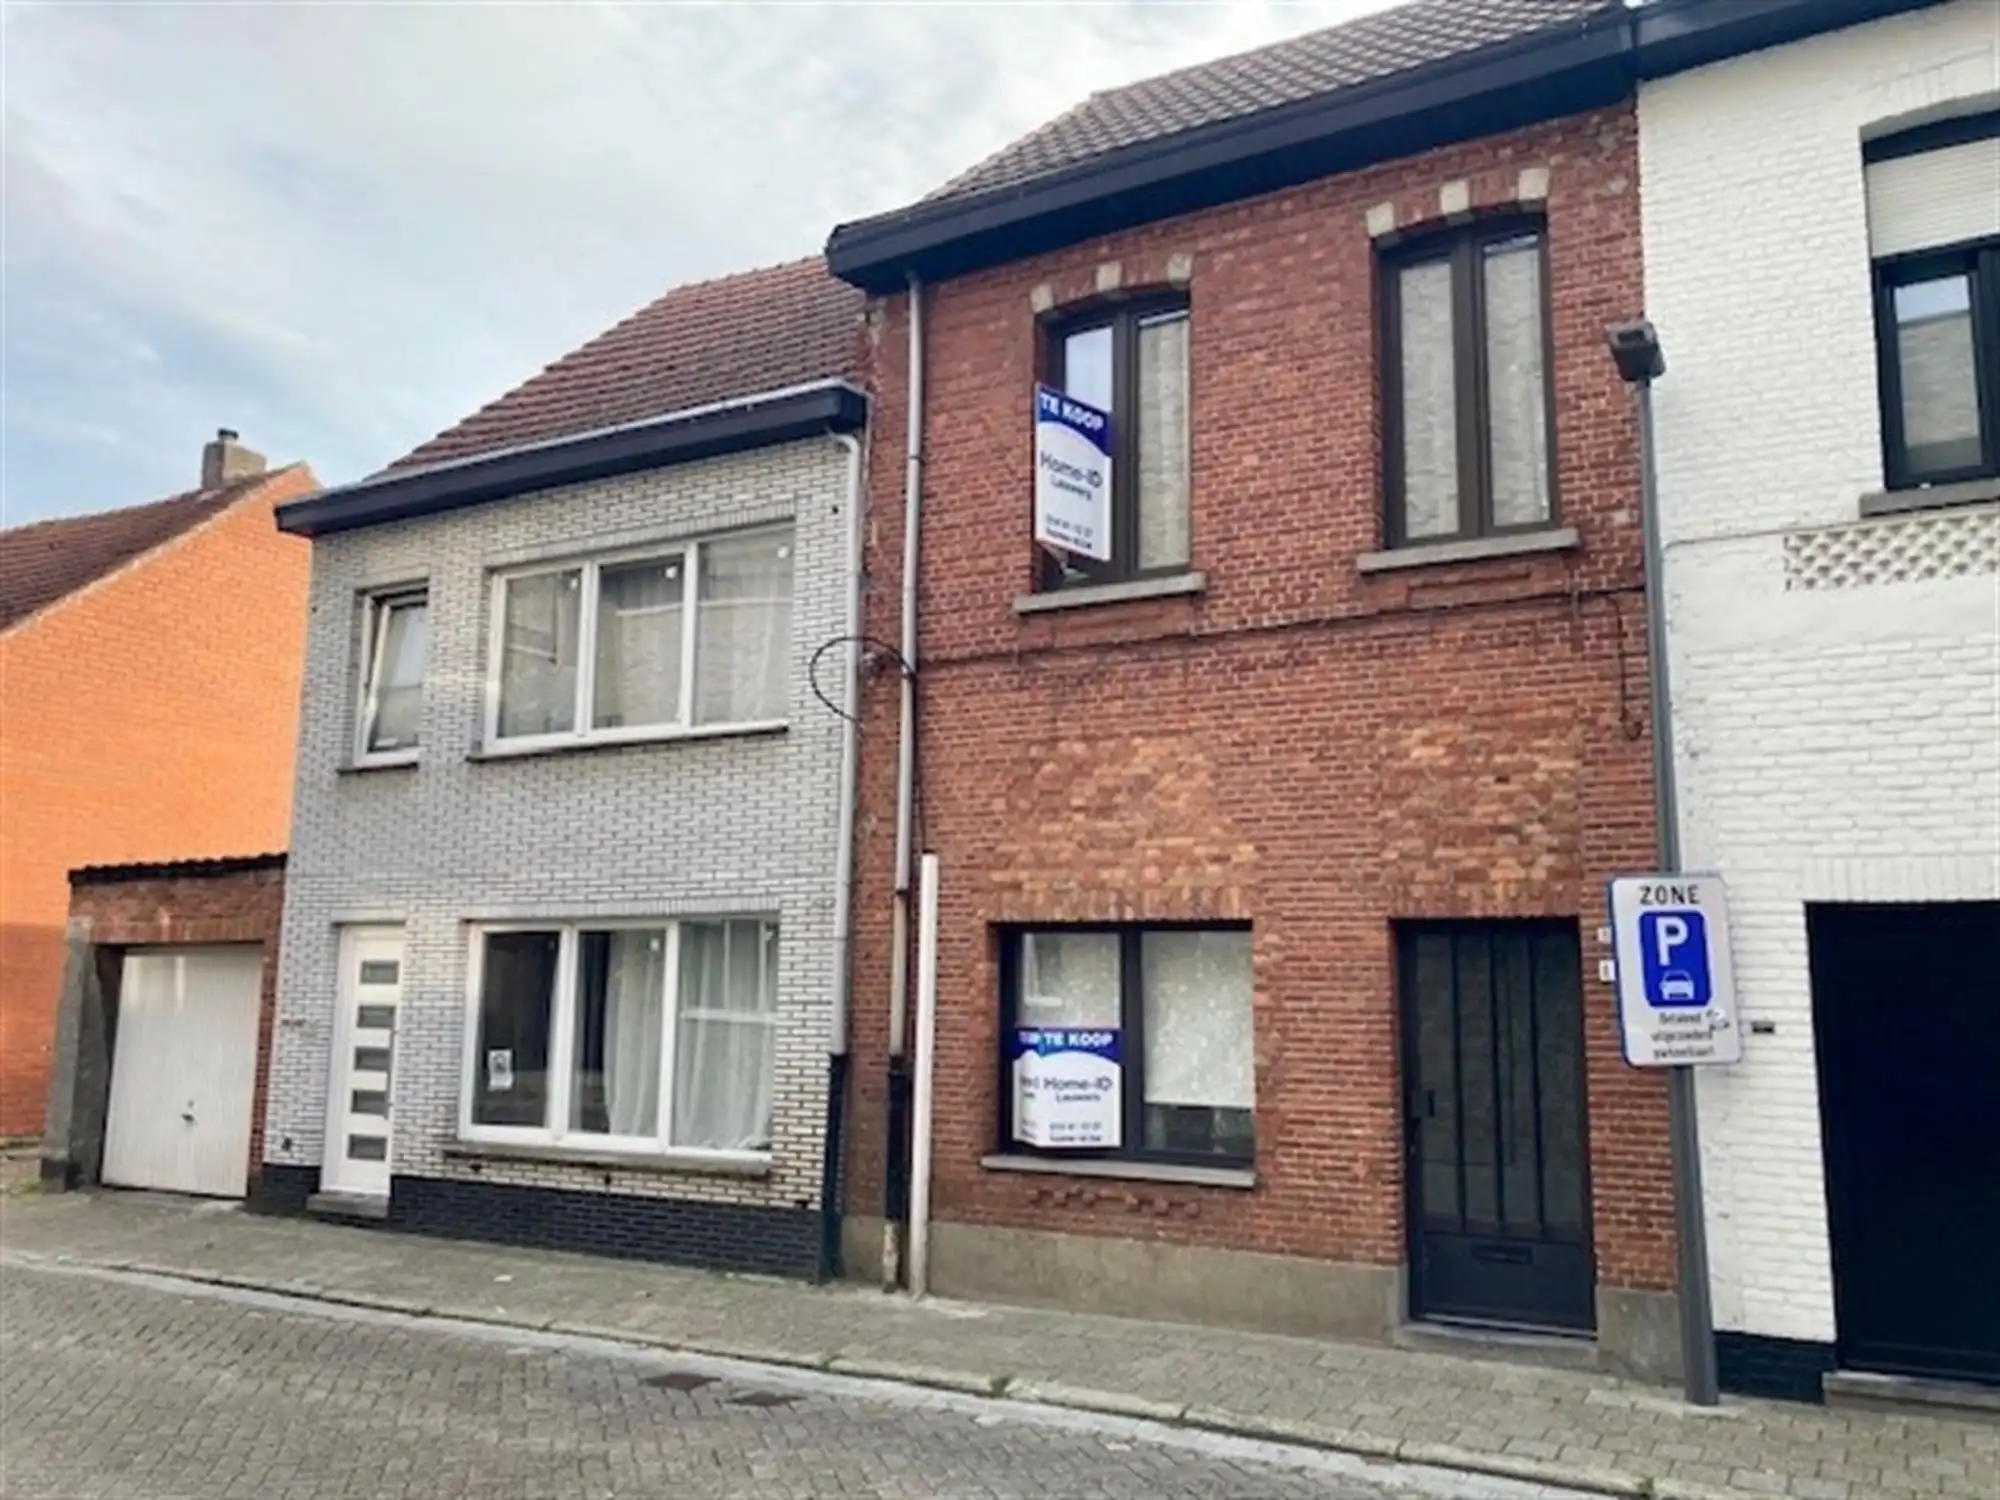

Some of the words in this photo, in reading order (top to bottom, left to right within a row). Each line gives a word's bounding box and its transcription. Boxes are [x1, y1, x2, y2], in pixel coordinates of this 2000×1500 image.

[1040, 393, 1060, 416] TE
[1062, 401, 1104, 430] KOOP
[1040, 451, 1104, 489] Home-ID
[1639, 885, 1700, 905] ZONE
[1656, 916, 1688, 966] P
[1044, 1032, 1064, 1045] TE
[1068, 1032, 1113, 1047] KOOP
[1043, 1076, 1113, 1092] Home-ID
